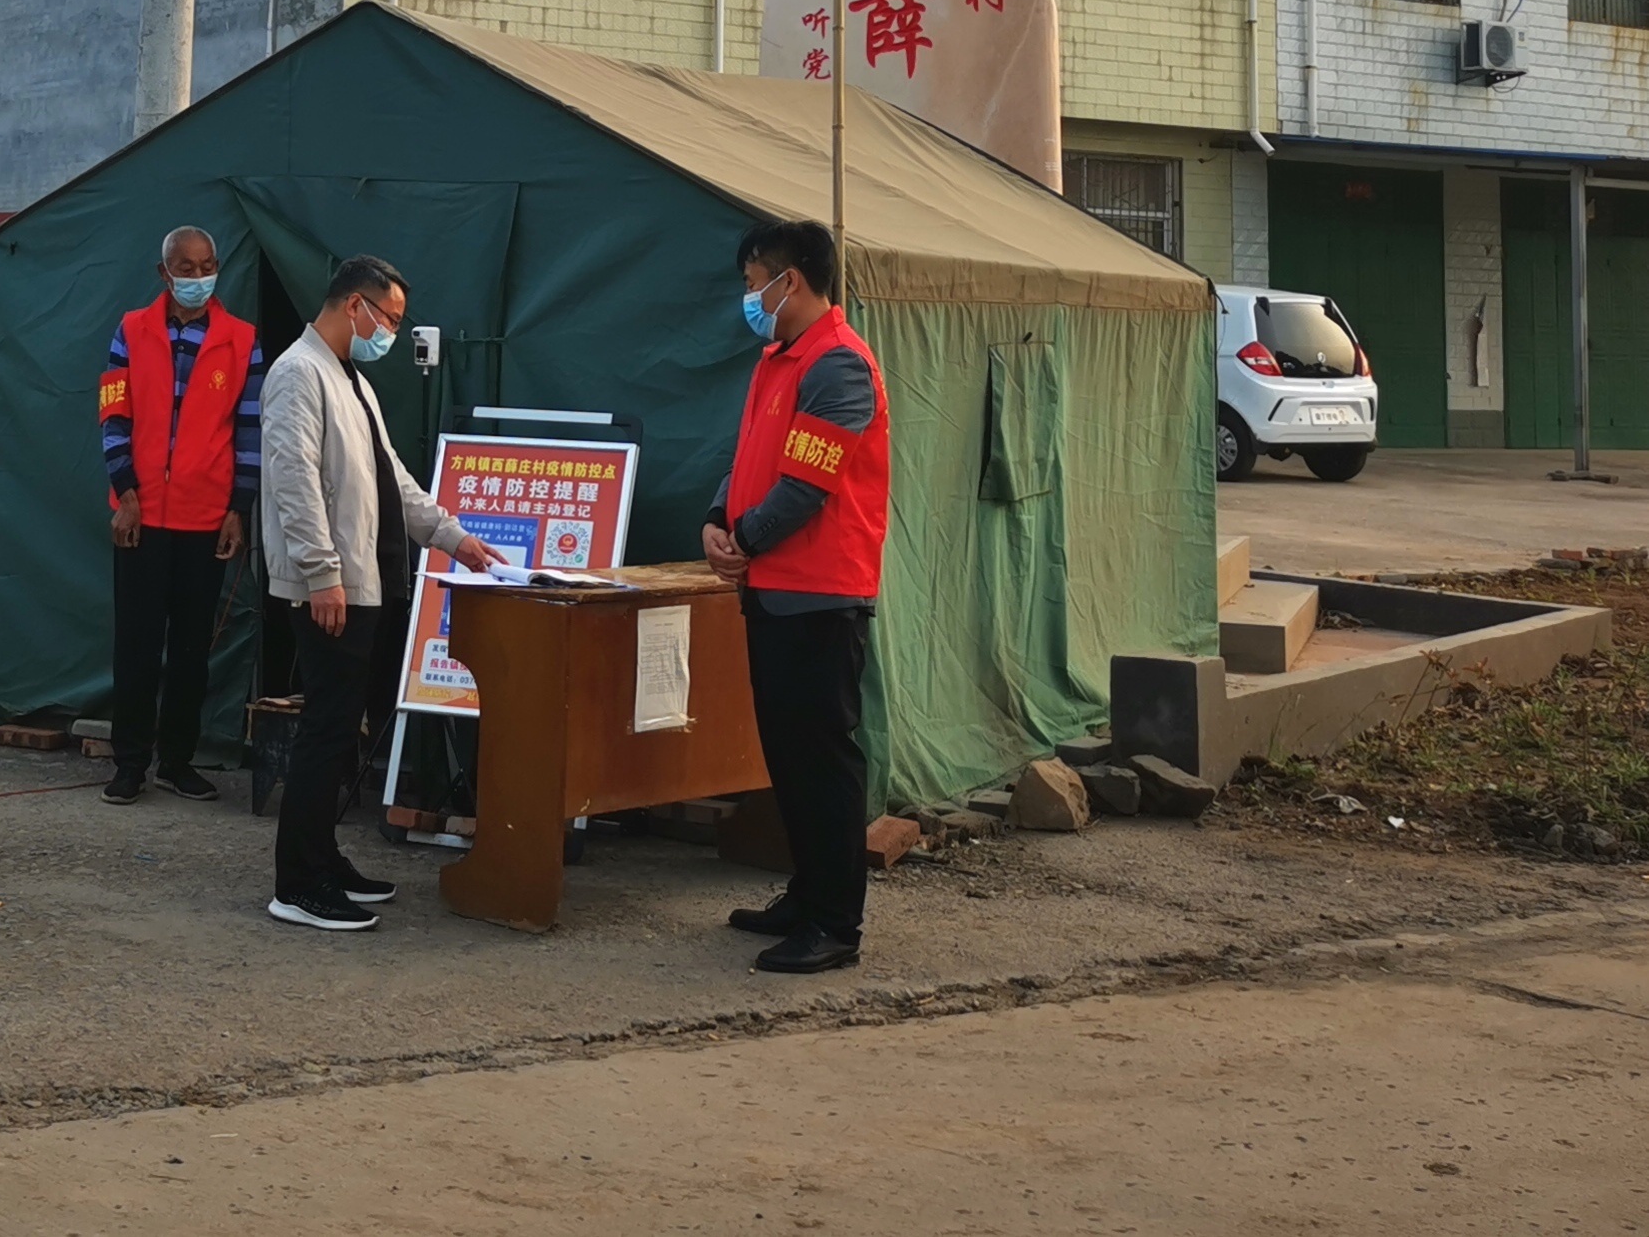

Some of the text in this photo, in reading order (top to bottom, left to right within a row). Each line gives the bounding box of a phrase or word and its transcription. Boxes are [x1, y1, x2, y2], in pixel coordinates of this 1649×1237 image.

[801, 7, 832, 80] 听党
[457, 475, 599, 503] 疫情防控提醒
[459, 497, 591, 519] 外来人员请主动登记
